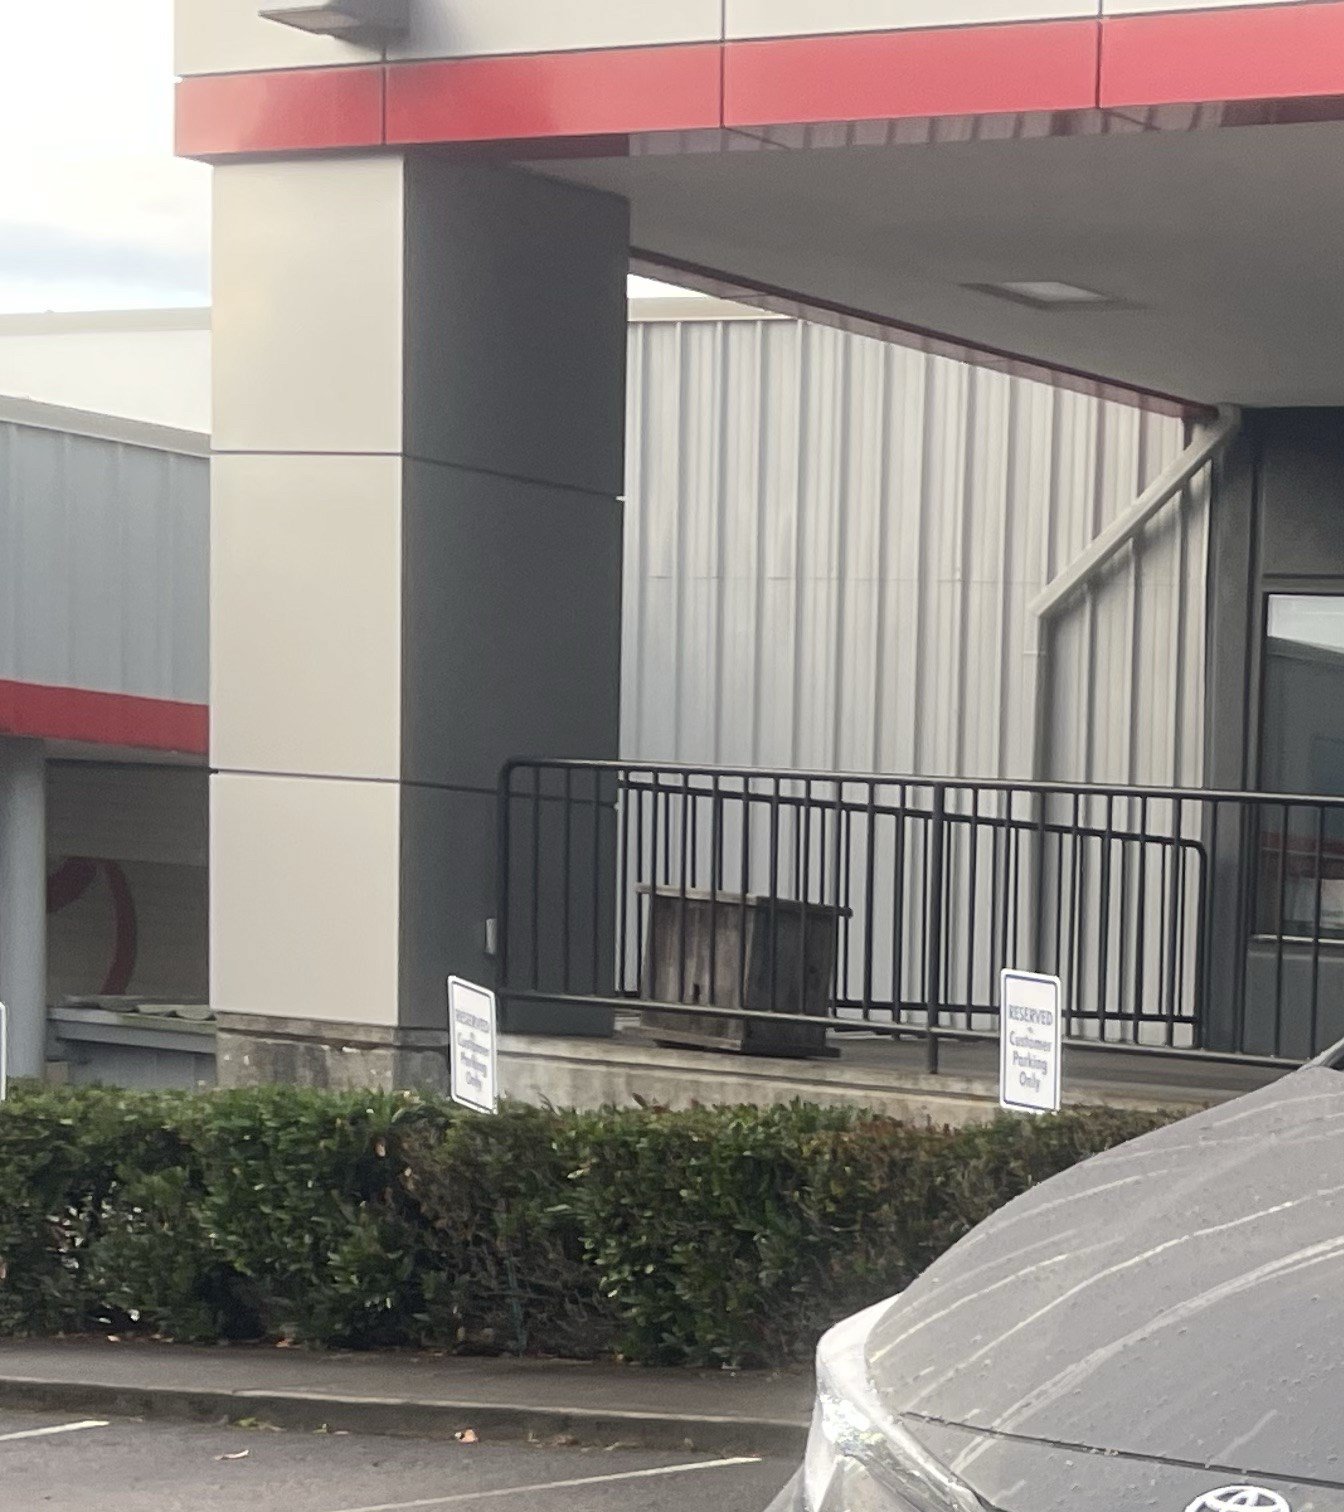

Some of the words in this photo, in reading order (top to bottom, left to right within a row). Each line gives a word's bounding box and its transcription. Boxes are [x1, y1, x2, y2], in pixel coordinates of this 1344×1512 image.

[1008, 1003, 1054, 1026] RESERVED
[1009, 1030, 1052, 1052] Customer
[1012, 1049, 1049, 1076] Parking
[1019, 1070, 1041, 1093] Only
